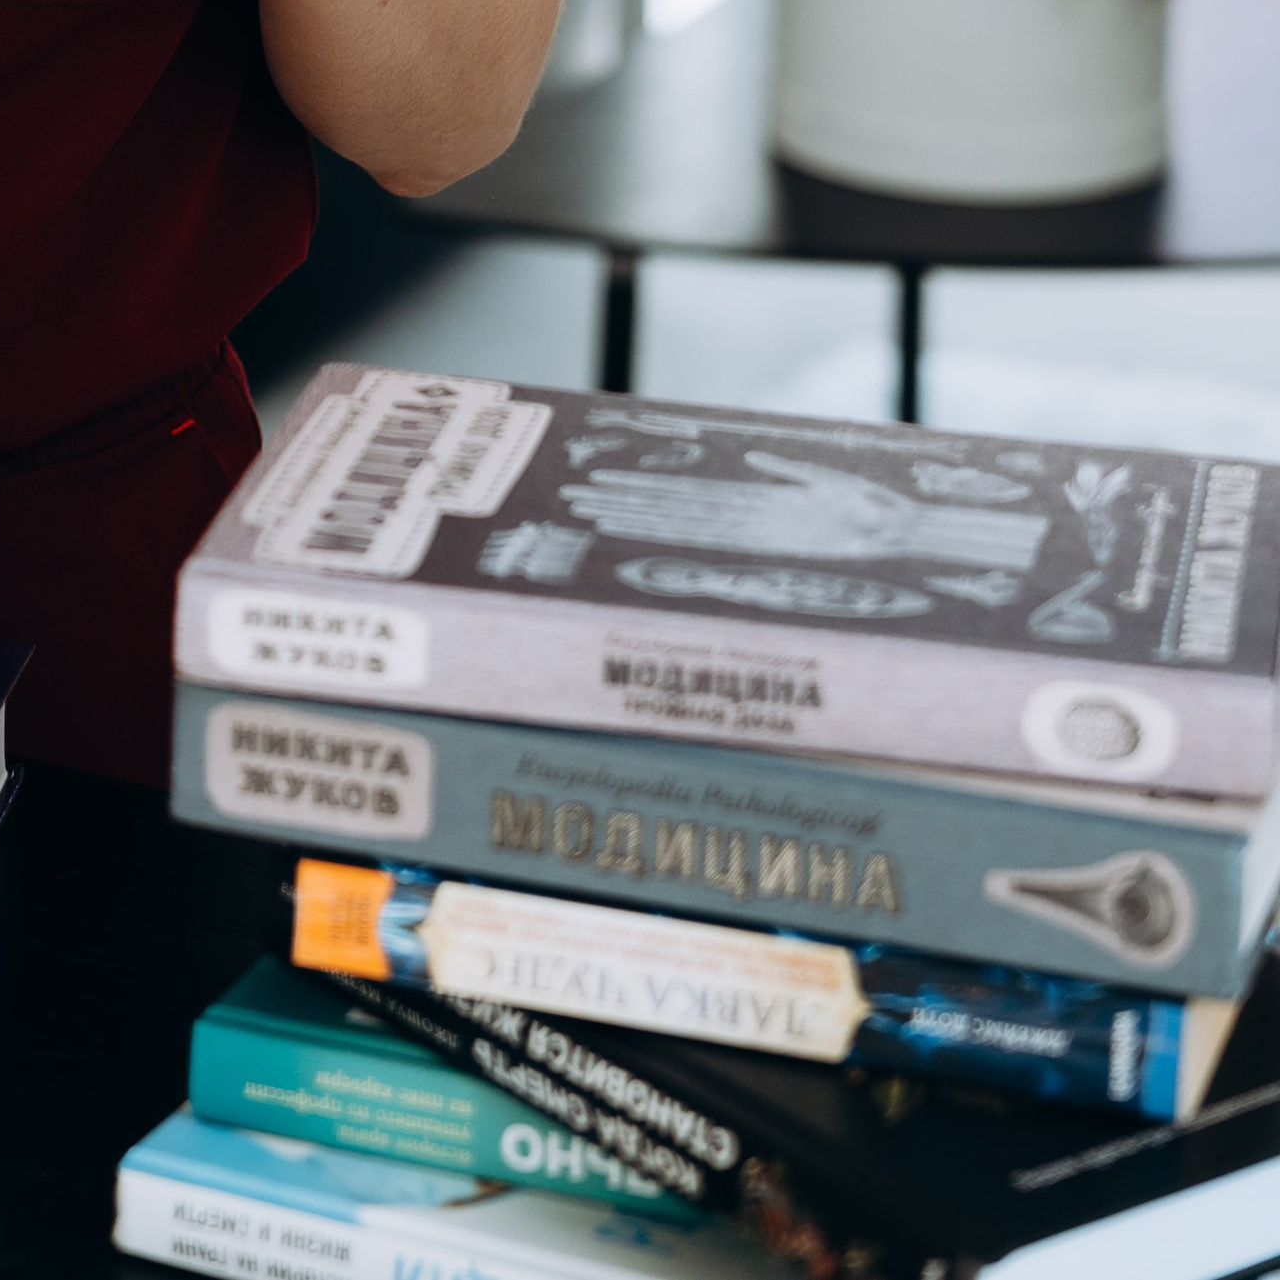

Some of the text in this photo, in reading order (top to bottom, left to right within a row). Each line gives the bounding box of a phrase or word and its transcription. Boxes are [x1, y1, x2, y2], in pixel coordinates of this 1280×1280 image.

[602, 656, 823, 708] МОДИЦИНА
[230, 720, 410, 777] НИКИТА
[240, 762, 402, 816] ЖУКОВ
[491, 788, 903, 914] МОДИЦИНА
[479, 946, 821, 1037] ЛАВКА ЧУДЕС
[471, 1038, 705, 1201] КОГДА СМЕРТЬ
[527, 1018, 739, 1171] СТАНОВИТСЯ
[173, 1198, 352, 1262] ЖИЗНИ И СМЕРТИ
